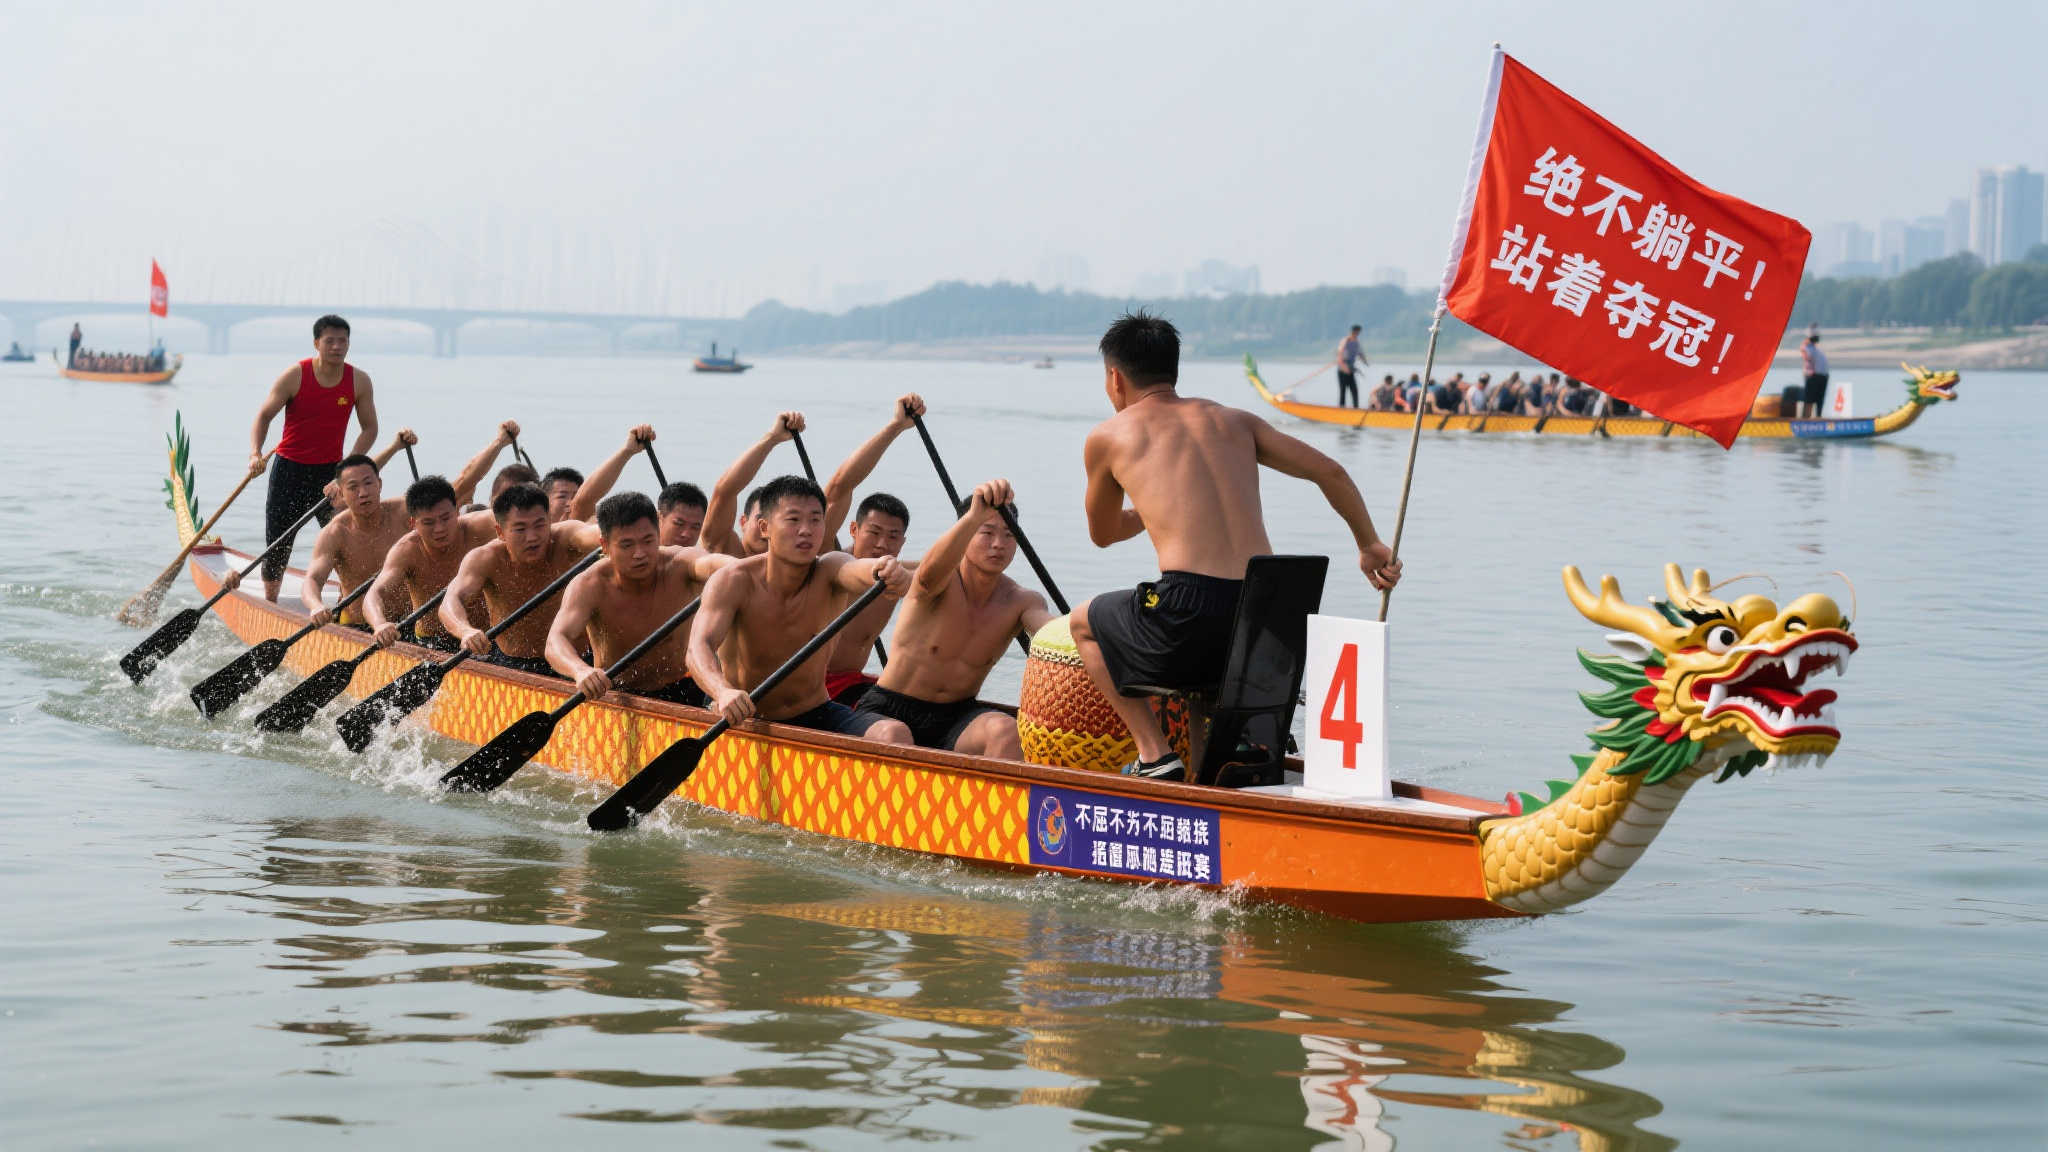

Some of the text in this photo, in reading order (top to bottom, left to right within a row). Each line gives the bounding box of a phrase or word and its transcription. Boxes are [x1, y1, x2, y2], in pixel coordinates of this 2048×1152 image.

[1491, 224, 1734, 375] 站着夺冠！
[1524, 147, 1766, 301] 绝不躺平！
[1320, 643, 1363, 769] 4
